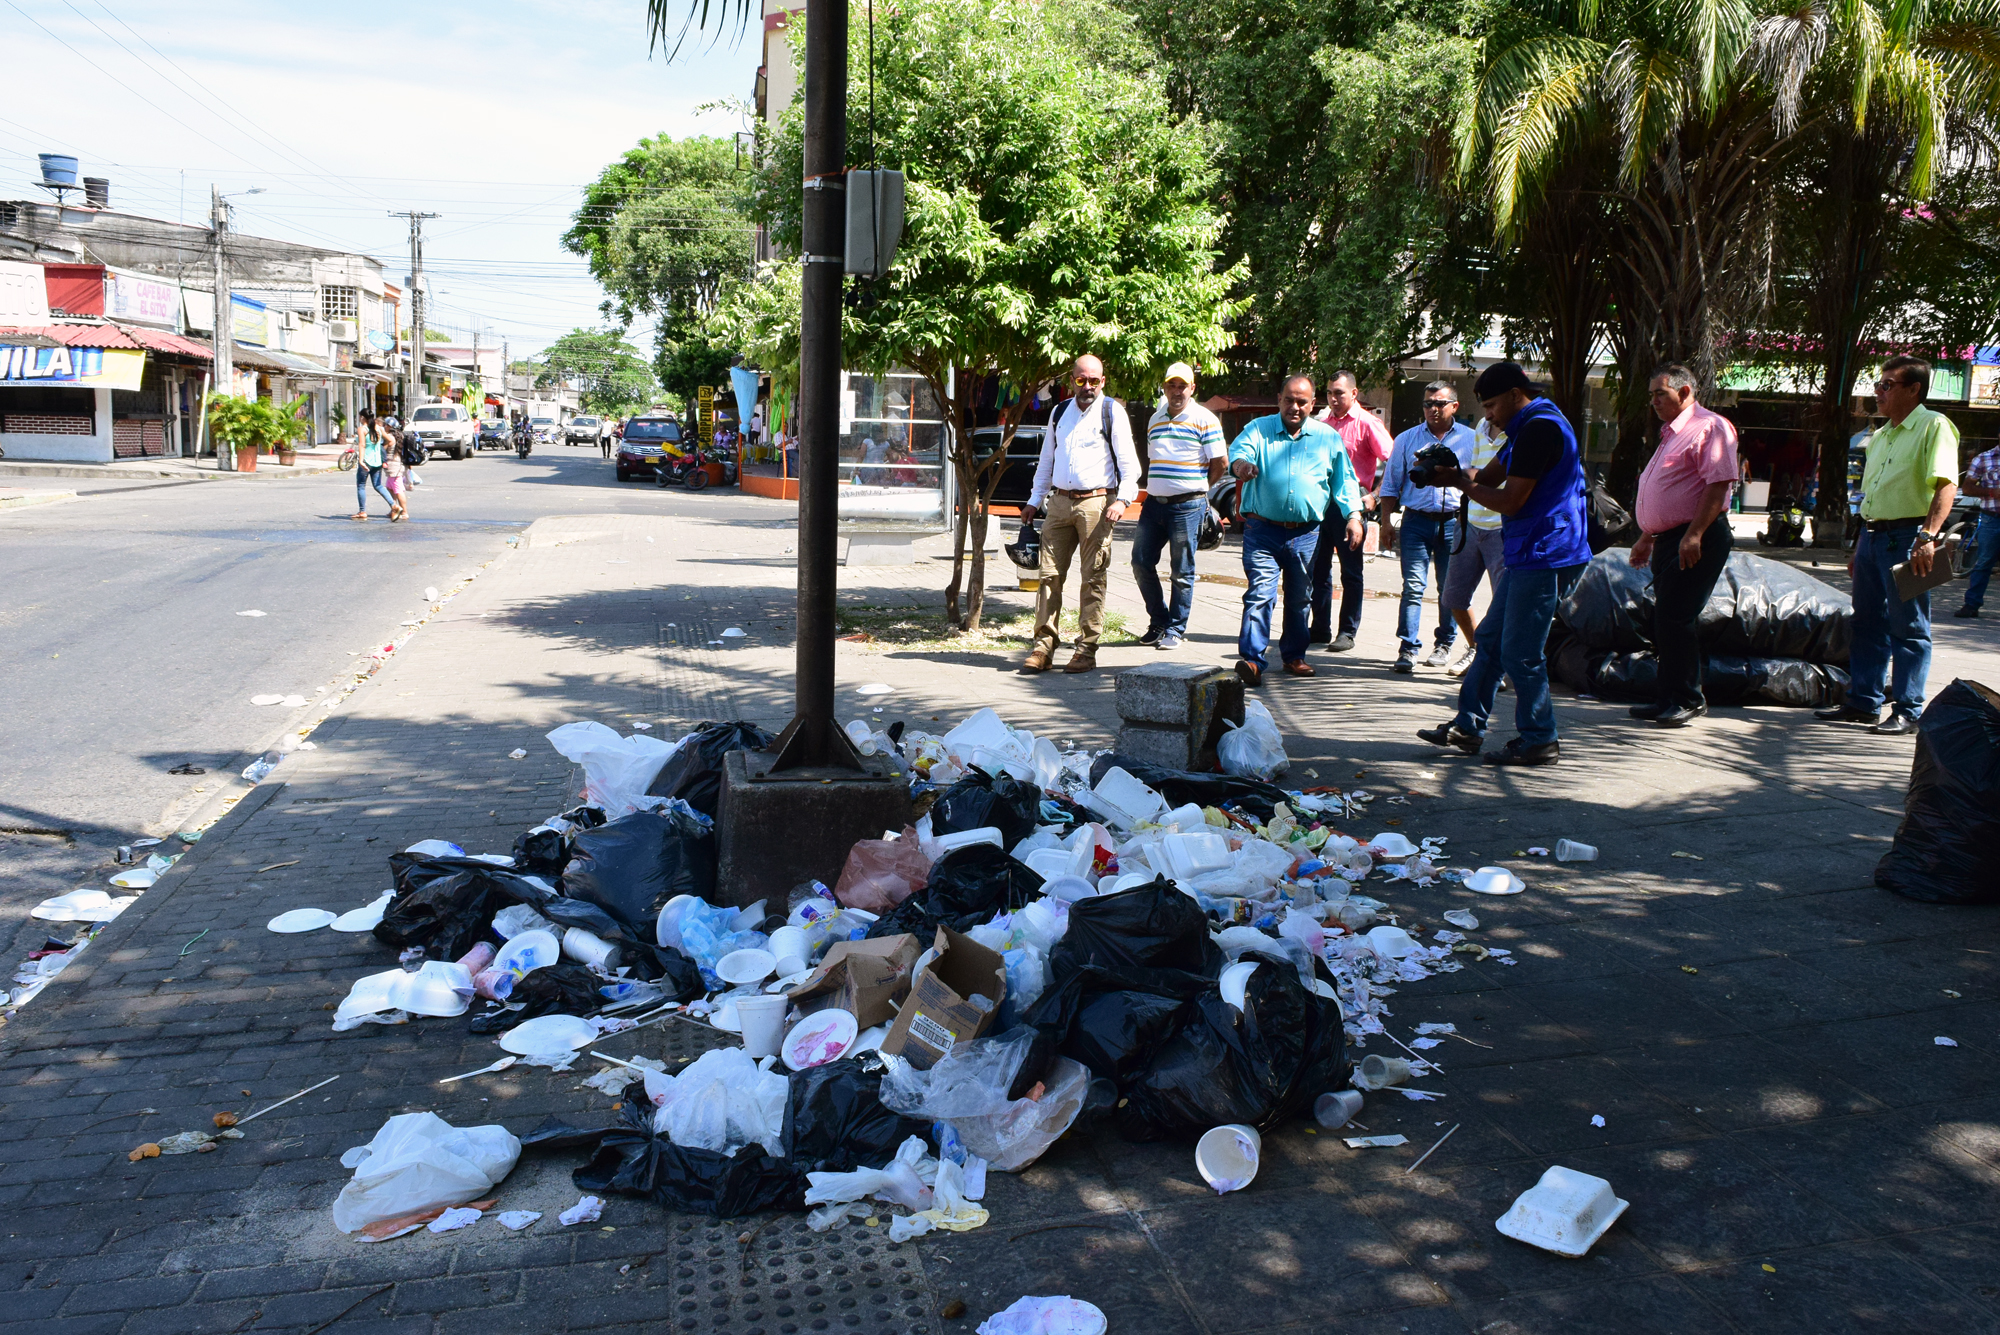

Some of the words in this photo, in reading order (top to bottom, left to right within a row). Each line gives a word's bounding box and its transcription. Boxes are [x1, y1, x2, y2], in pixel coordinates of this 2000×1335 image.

[156, 285, 172, 302] BAR
[140, 300, 148, 315] EL
[149, 301, 167, 318] SITIO
[699, 398, 712, 443] CORPETROL
